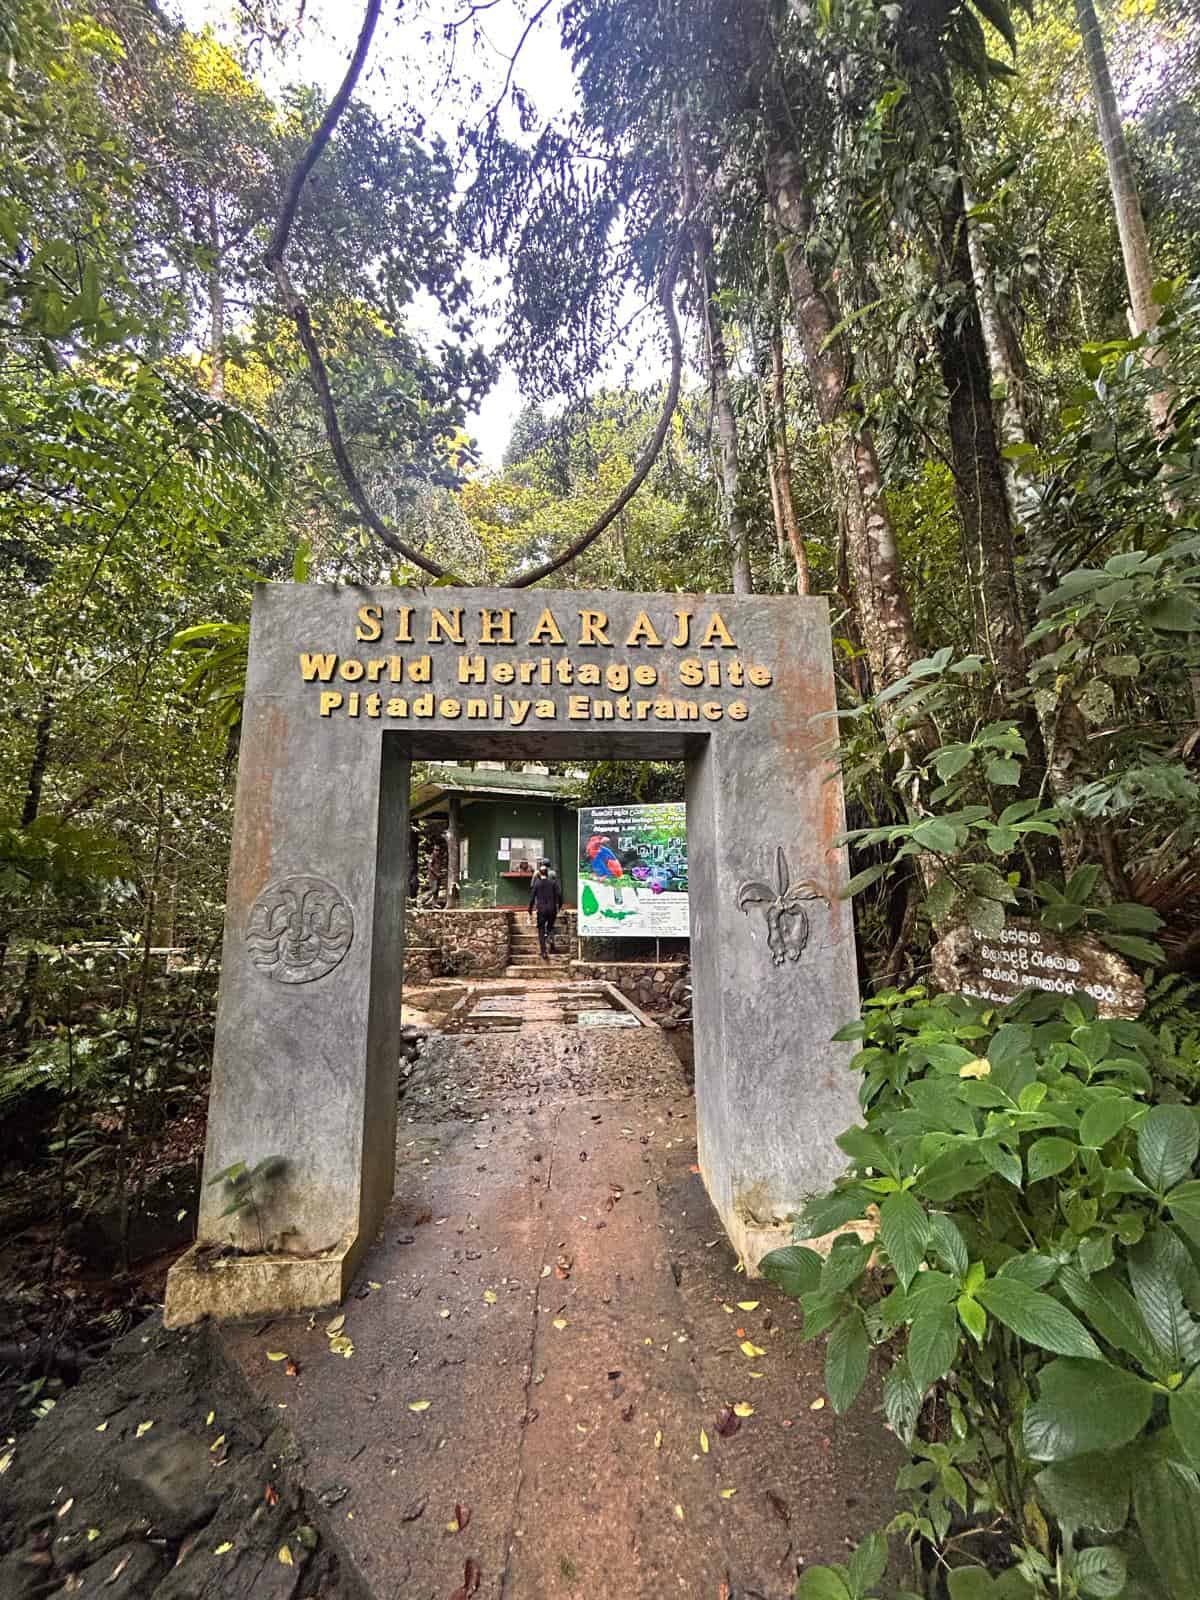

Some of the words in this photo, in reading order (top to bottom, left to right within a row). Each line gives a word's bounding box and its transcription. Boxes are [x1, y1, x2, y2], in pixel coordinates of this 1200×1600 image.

[355, 604, 738, 648] SINHARAJA
[300, 653, 432, 683] World
[458, 655, 658, 692] Heritage
[678, 658, 773, 688] Site
[319, 691, 556, 726] Pitadeniya
[568, 695, 749, 721] Entrance
